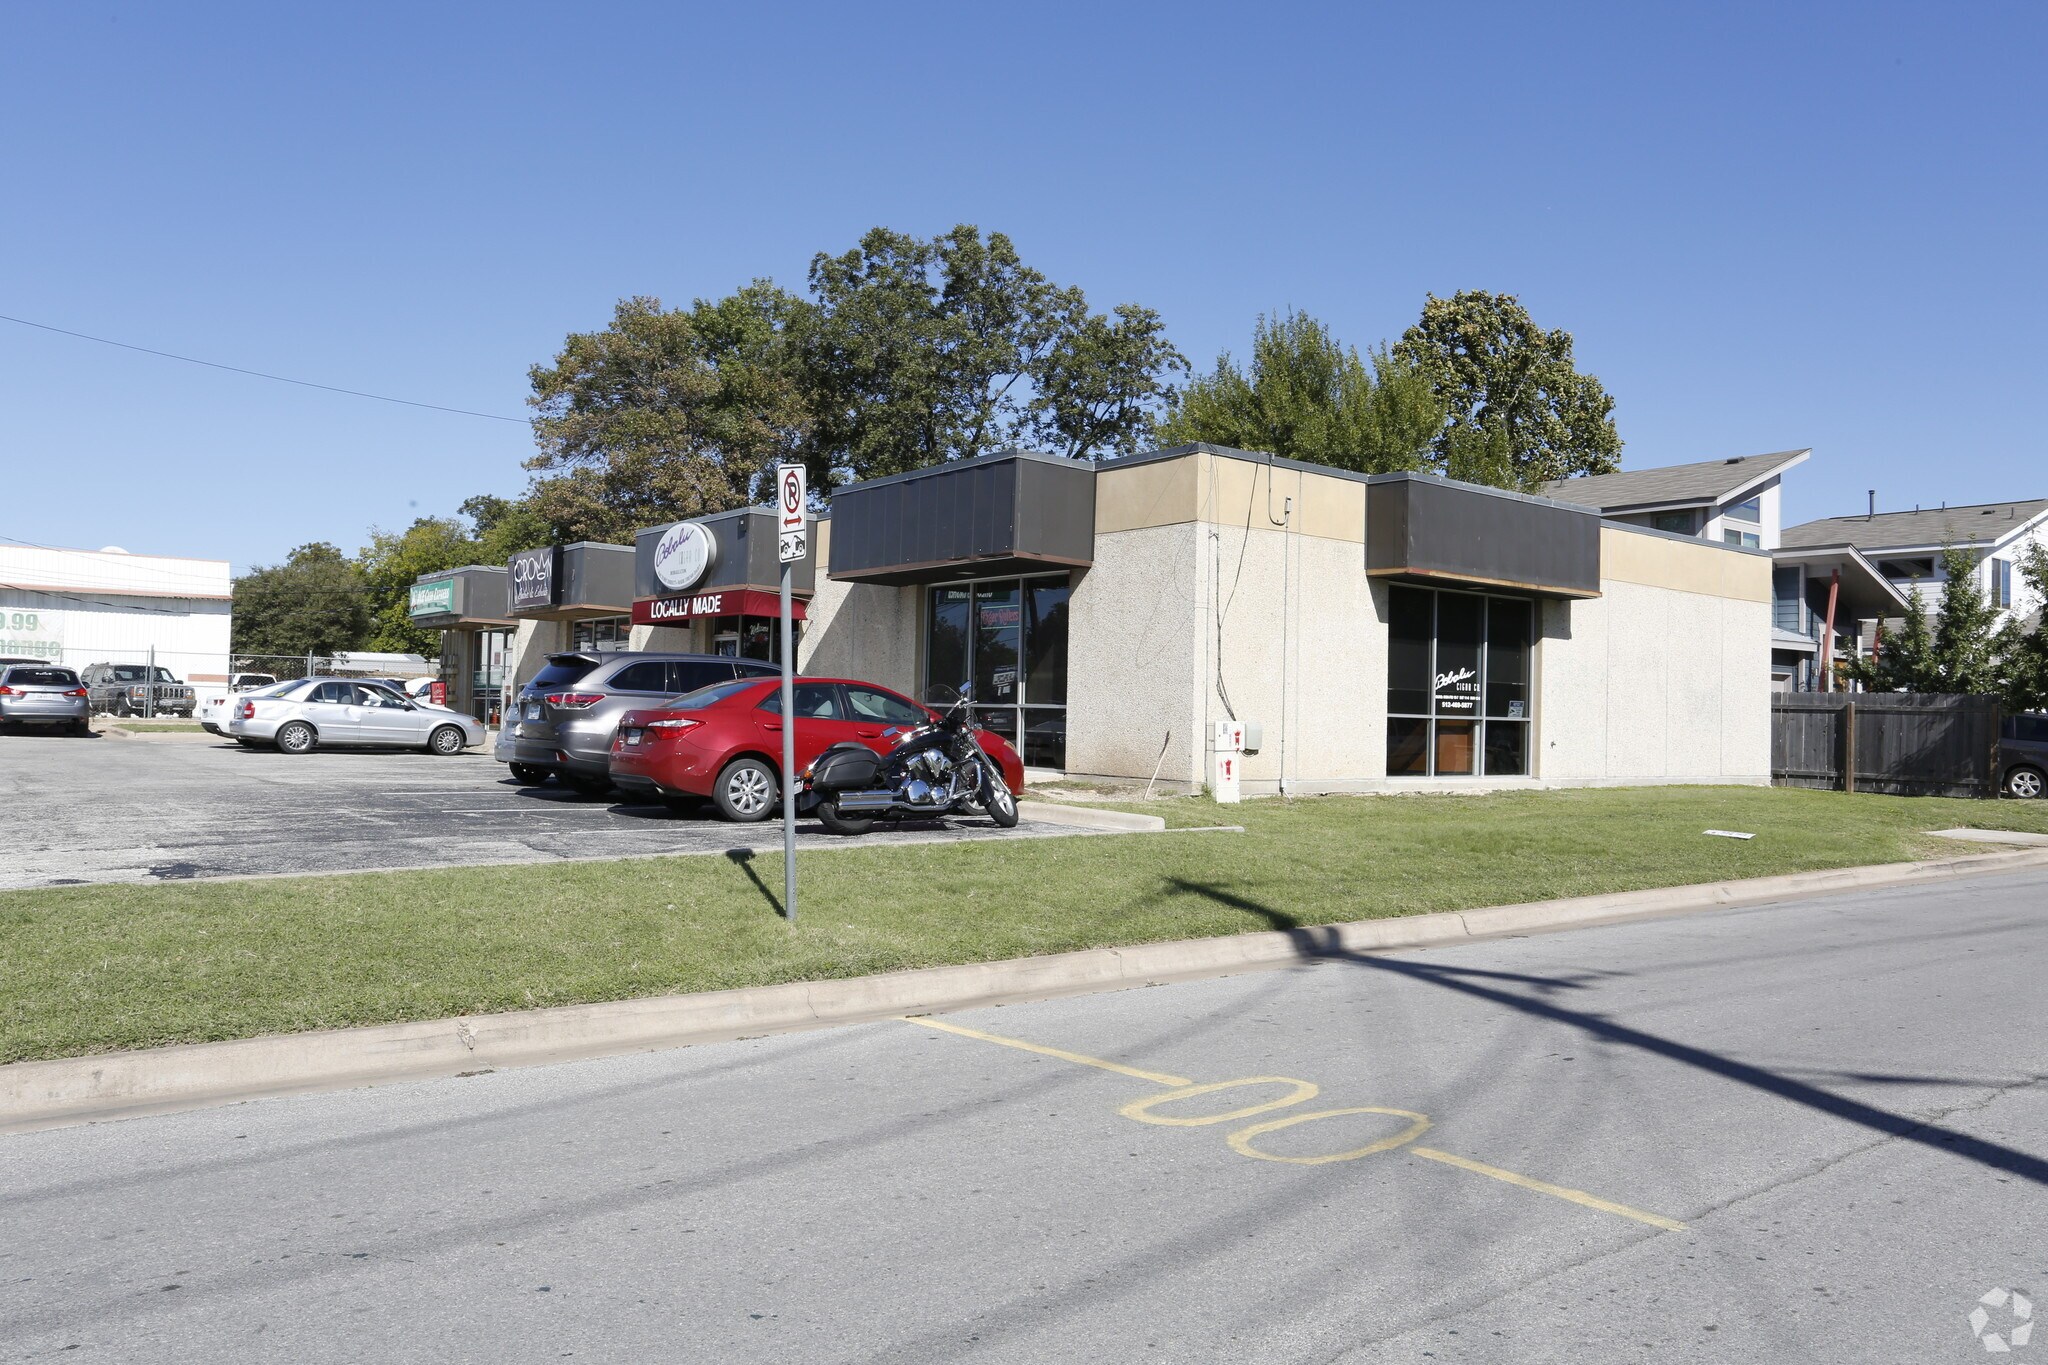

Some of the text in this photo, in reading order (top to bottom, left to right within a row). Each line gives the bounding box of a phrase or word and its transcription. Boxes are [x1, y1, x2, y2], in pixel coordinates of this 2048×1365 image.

[656, 528, 695, 567] Bobalu
[514, 553, 552, 582] CROWN
[651, 595, 722, 618] LOCALLY MADE
[1435, 667, 1476, 690] Bobalu
